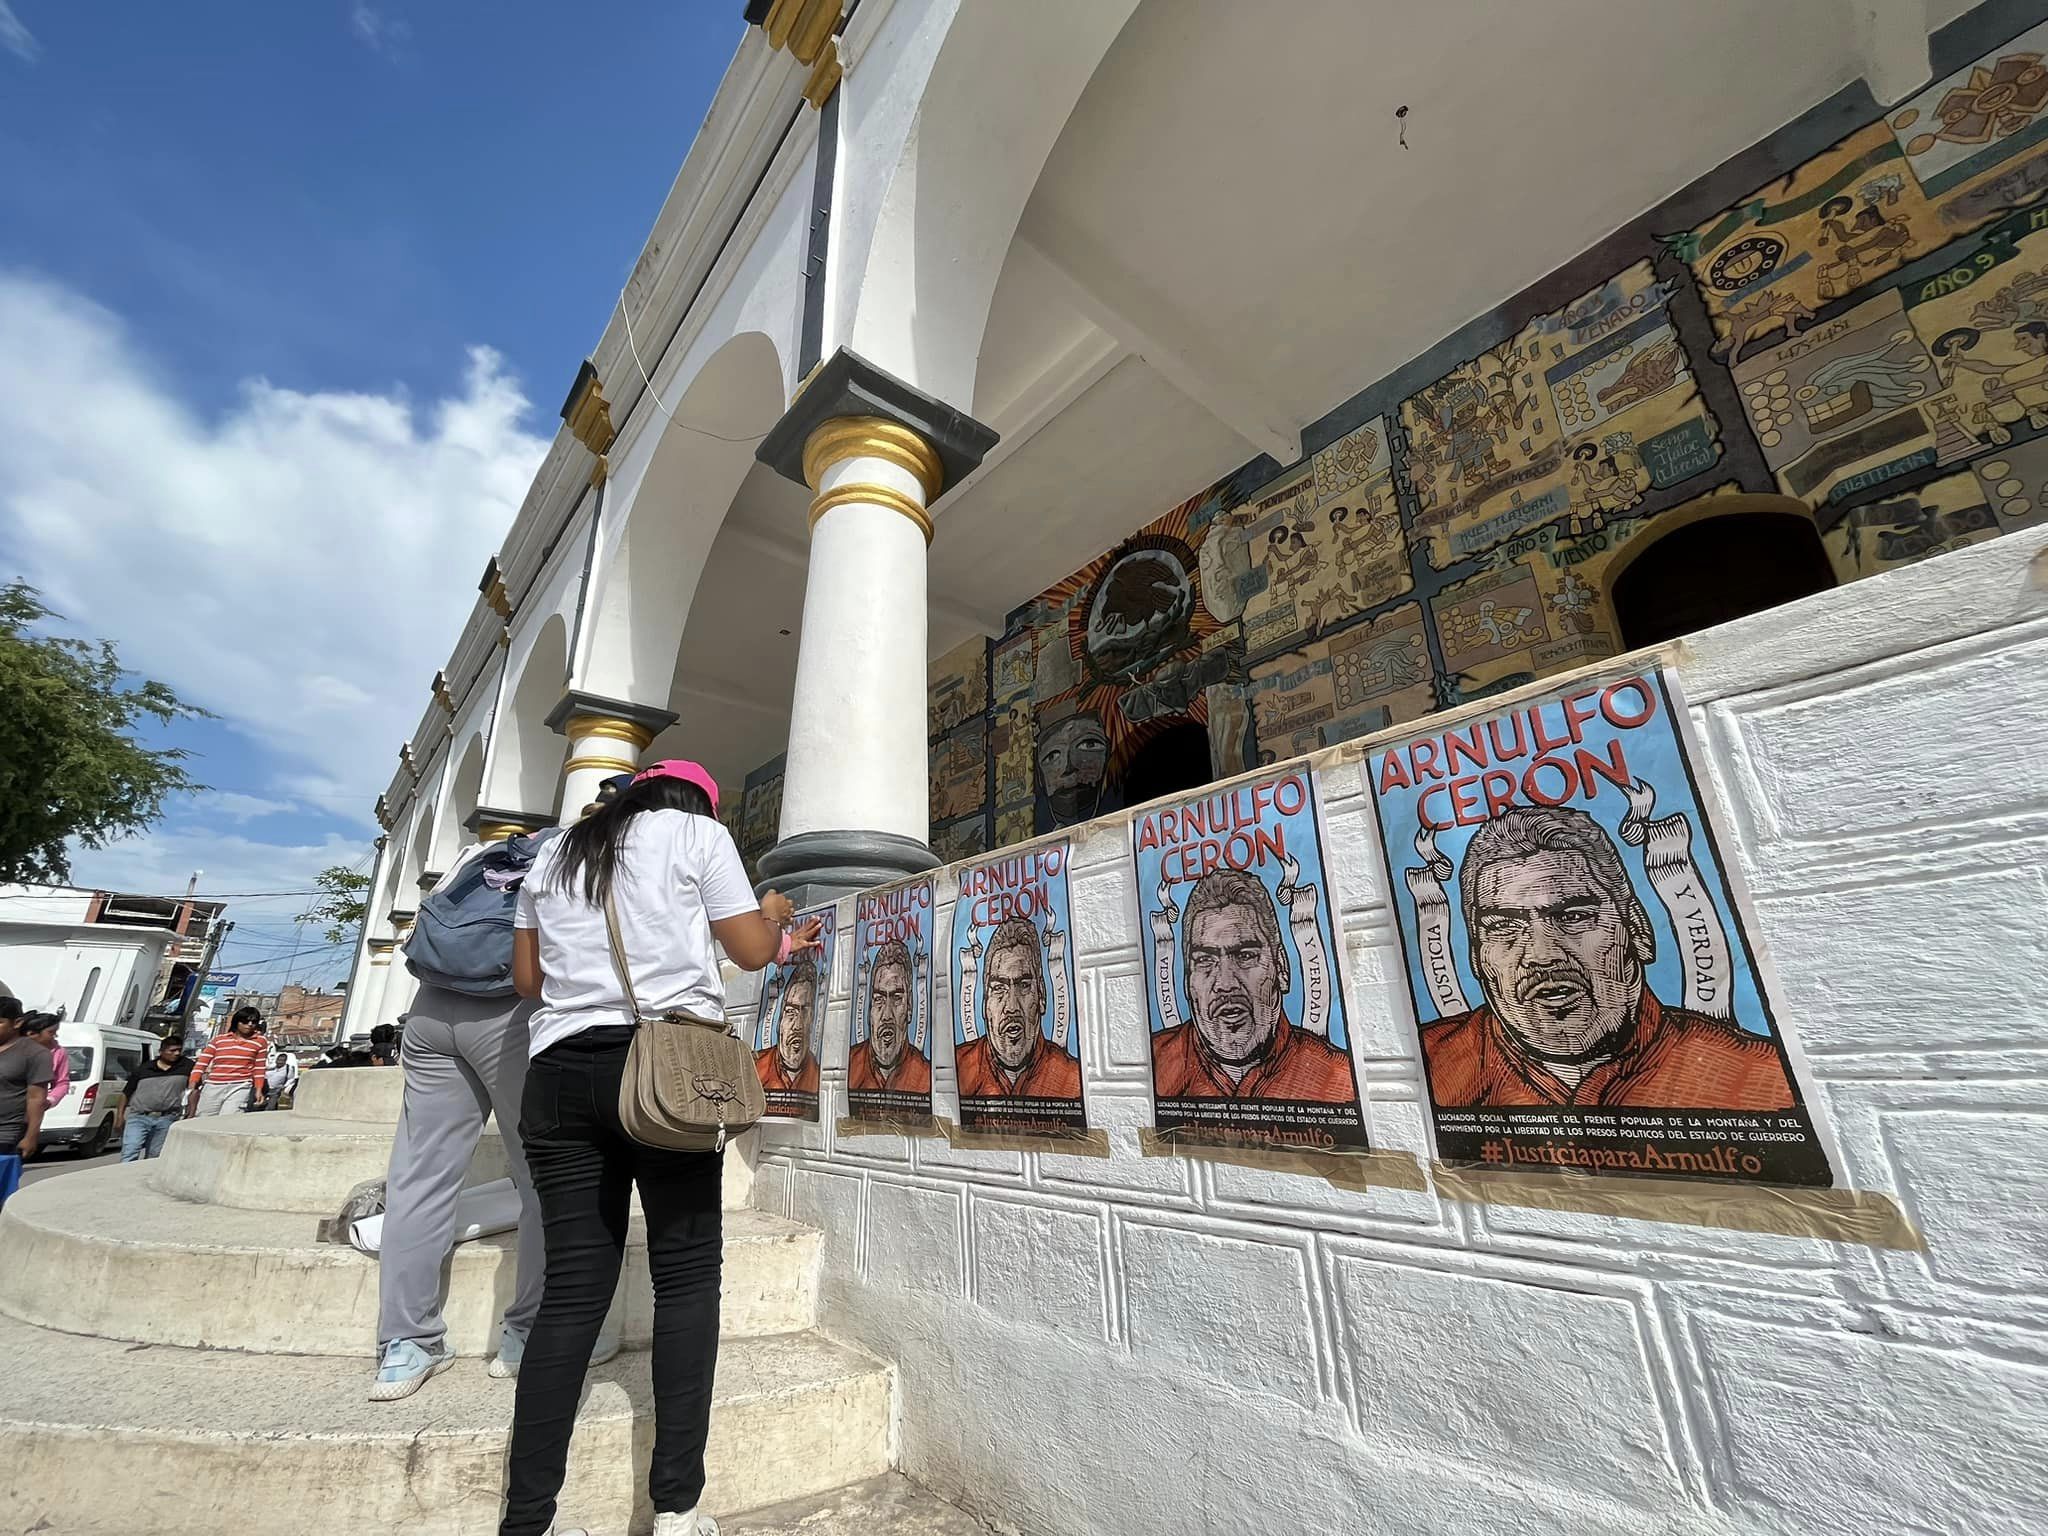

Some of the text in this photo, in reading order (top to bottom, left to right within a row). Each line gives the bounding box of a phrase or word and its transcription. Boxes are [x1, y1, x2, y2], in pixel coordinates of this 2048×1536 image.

[1975, 254, 1995, 270] 9
[1576, 294, 1645, 341] VENADO
[1539, 531, 1550, 544] 8
[1552, 534, 1608, 569] VIENTO
[1380, 677, 1657, 795] ARNULFO
[1139, 775, 1306, 852] ARNULFO
[960, 847, 1064, 897] ARNULFO
[858, 880, 931, 922] ARNULFO
[1428, 923, 1462, 1007] JUSTICIA
[1673, 884, 1716, 1002] Y VERDAD
[1159, 956, 1178, 1020] JUSTICIA
[1304, 936, 1322, 1024] Y VERDAD
[1438, 1113, 1476, 1122] LUCHADOR
[1479, 1114, 1505, 1122] SOCIAL
[1509, 1115, 1559, 1124] INTEGRANTE
[1563, 1115, 1580, 1124] DEL
[1584, 1116, 1616, 1125] FRENTE
[1621, 1116, 1664, 1126] POPULAR
[1669, 1117, 1682, 1127] DE
[1688, 1118, 1701, 1127] LA
[1764, 1118, 1773, 1127] Y
[1778, 1118, 1802, 1128] DEL
[1440, 1125, 1482, 1133] MOVIMIENTO
[1485, 1125, 1501, 1134] POR
[1503, 1126, 1512, 1134] LA
[1514, 1126, 1550, 1136] LIBERTAD
[1553, 1127, 1565, 1136] DE
[1567, 1128, 1583, 1137] LOS
[1586, 1128, 1618, 1138] PRESOS
[1668, 1130, 1687, 1140] DEL
[1690, 1131, 1728, 1141] ESTADO
[1731, 1132, 1744, 1141] DE
[1749, 1132, 1806, 1142] GUERRERO
